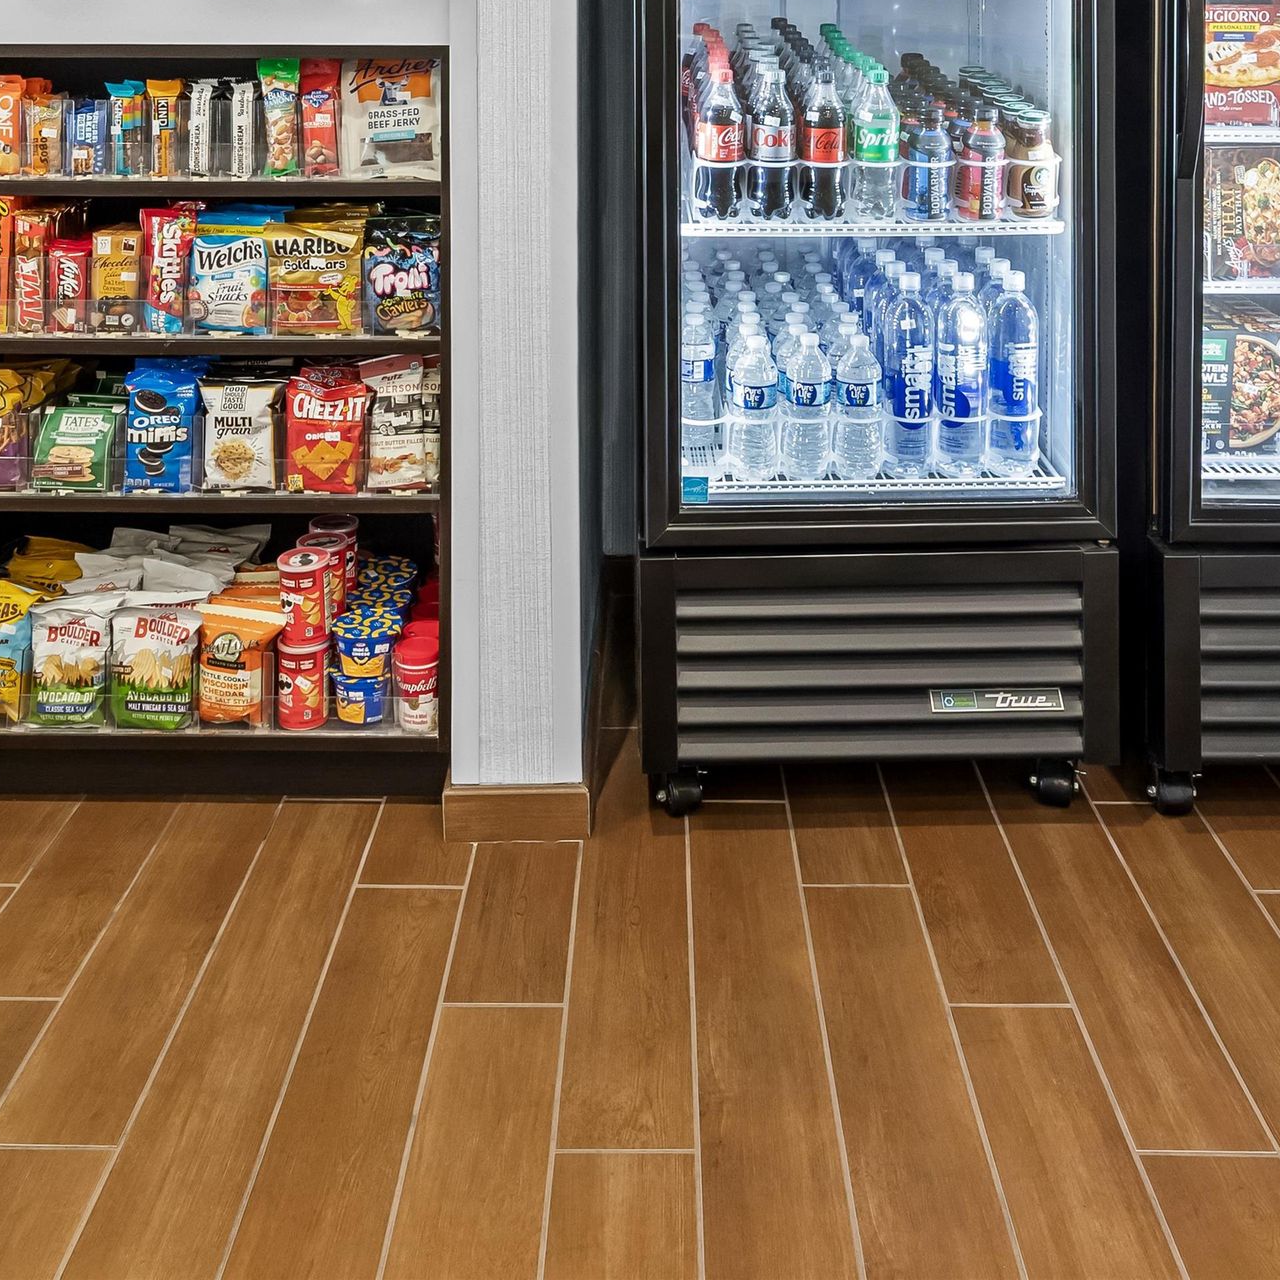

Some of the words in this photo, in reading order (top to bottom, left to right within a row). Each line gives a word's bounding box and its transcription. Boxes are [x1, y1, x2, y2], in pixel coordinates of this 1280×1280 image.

[349, 58, 440, 89] Archer
[268, 91, 287, 99] BLUE
[1205, 88, 1276, 109] AND-TOSSED
[114, 99, 122, 125] KIND
[157, 100, 168, 126] KIND
[368, 108, 420, 120] GRASS-FED
[368, 119, 390, 129] BEEF
[392, 117, 421, 127] JERKY
[754, 128, 795, 147] Coke
[858, 129, 901, 149] Sprite
[39, 128, 48, 164] OBO'S
[1222, 189, 1234, 236] THAI
[275, 237, 352, 256] HARIBO
[197, 240, 263, 270] Welch's
[1224, 237, 1243, 271] Amy's
[160, 222, 182, 303] Skittles
[370, 264, 428, 295] Trolli
[216, 282, 244, 294] Fruit
[207, 292, 248, 304] Snacks
[377, 299, 428, 320] Crawlers
[796, 384, 814, 393] Pure
[849, 384, 867, 393] Pure
[746, 393, 760, 401] Life
[798, 391, 811, 400] Life
[851, 391, 865, 400] Life
[293, 393, 370, 421] CHEEZ-IT
[64, 416, 99, 428] TATE'S
[133, 415, 180, 428] OREO
[214, 416, 252, 428] MULTI
[216, 426, 251, 439] grain
[305, 431, 341, 441] ORIG
[407, 437, 423, 445] FILLED
[47, 625, 100, 647] BOULDER
[134, 617, 191, 646] BOULDER
[201, 669, 221, 680] KETTLE
[202, 676, 248, 690] WISCONSIN
[396, 675, 437, 694] Campbell's
[37, 691, 80, 703] AVOCADO
[127, 691, 171, 702] AVOCADO
[175, 692, 191, 702] OIL
[204, 686, 245, 697] CHEDDAR
[985, 692, 1056, 707] true
[142, 703, 161, 711] VINEGAR
[167, 704, 177, 712] SEA
